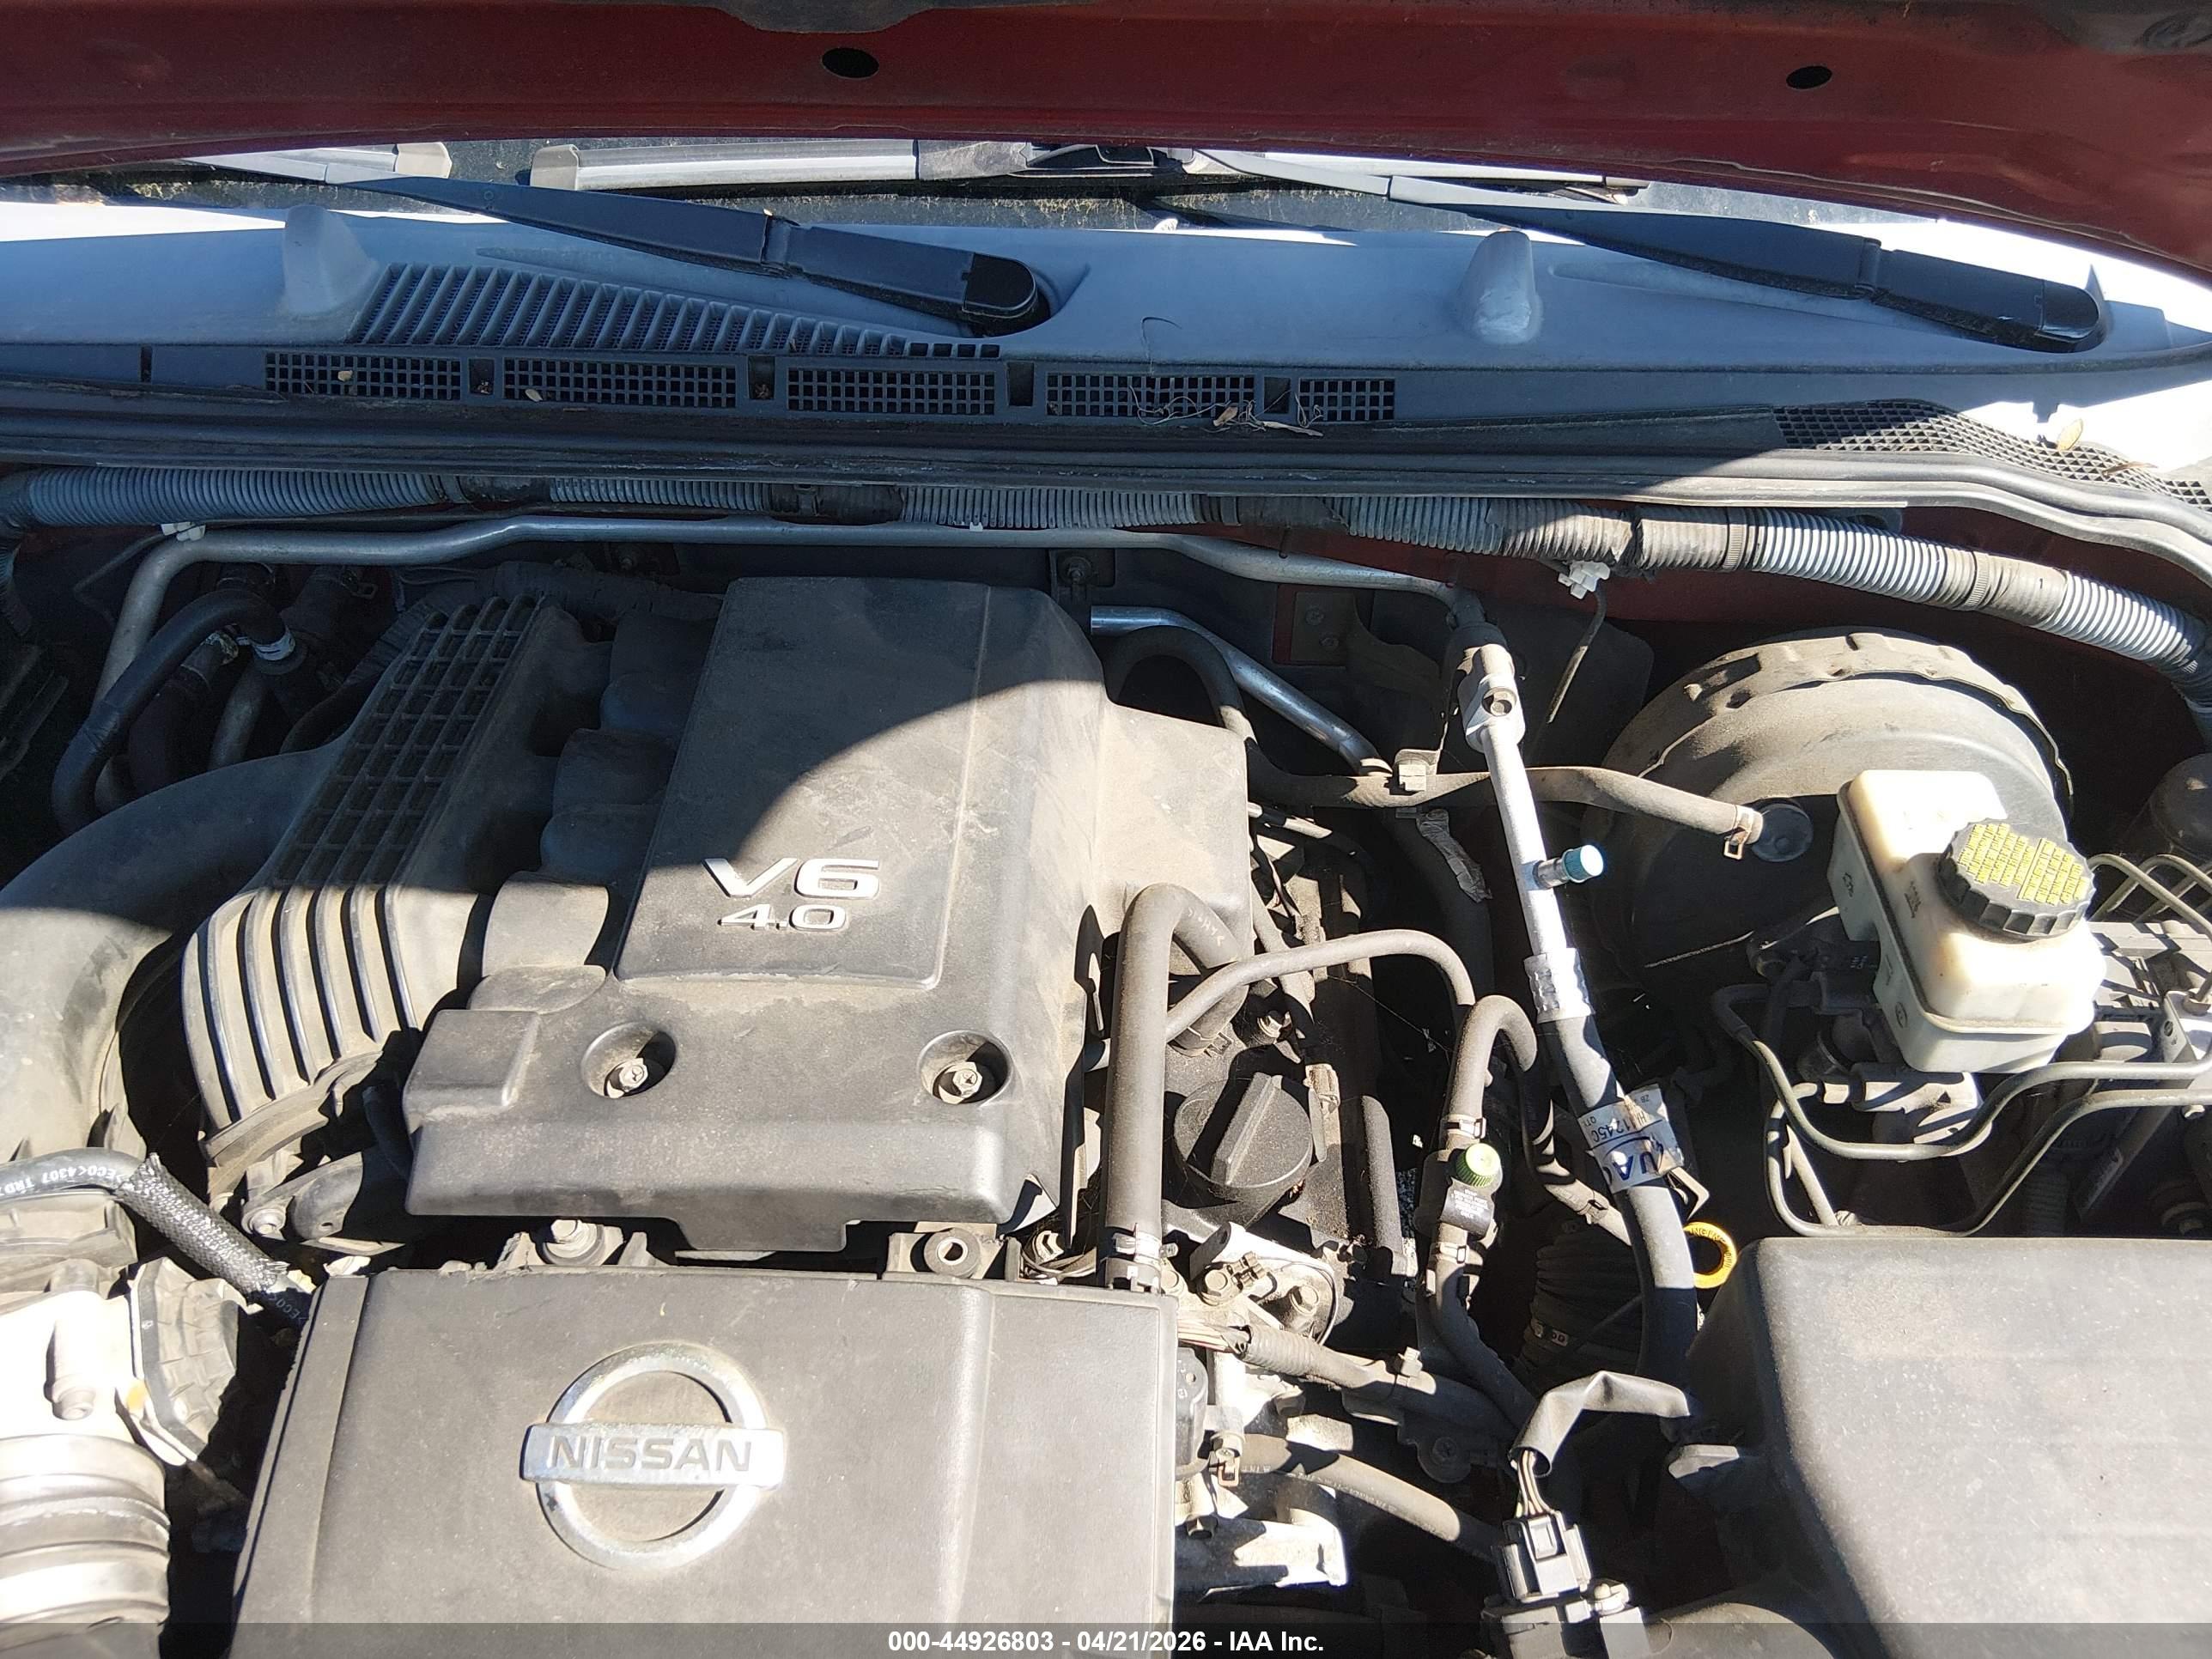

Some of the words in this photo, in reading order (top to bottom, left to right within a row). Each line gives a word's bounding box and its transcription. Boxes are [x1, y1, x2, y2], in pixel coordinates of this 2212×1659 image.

[702, 857, 879, 899] V6
[718, 903, 847, 931] 4.0
[548, 1435, 751, 1472] NISSAN
